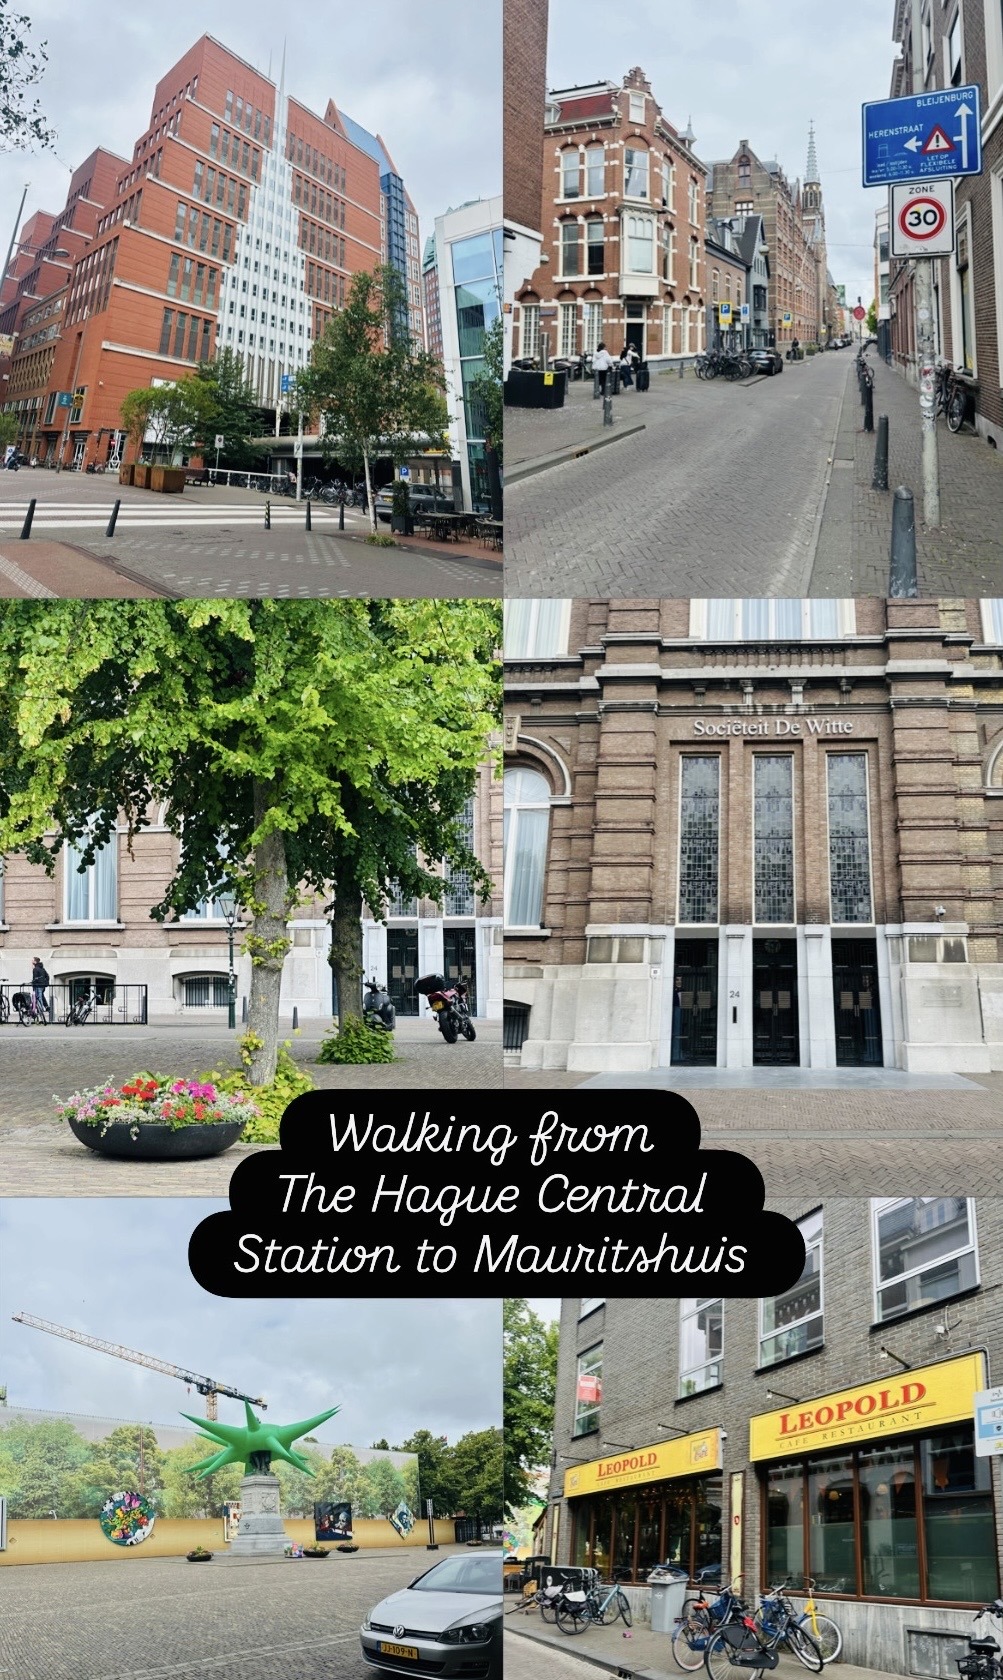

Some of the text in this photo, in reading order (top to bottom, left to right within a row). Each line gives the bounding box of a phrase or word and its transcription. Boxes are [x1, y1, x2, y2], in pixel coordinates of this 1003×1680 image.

[916, 91, 974, 108] BLEIJENBURG
[868, 123, 924, 139] HERENSTRAAT
[920, 158, 956, 167] FLEXIBELE
[920, 165, 957, 173] AFSLUITING
[909, 185, 935, 195] ZONE
[908, 209, 938, 227] 30
[693, 718, 854, 736] Sociëteit De Witte
[729, 990, 740, 999] 24
[779, 1382, 927, 1435] LEOPOLD
[822, 1411, 923, 1440] RESTAURANT
[597, 1452, 658, 1477] LEOPOLD
